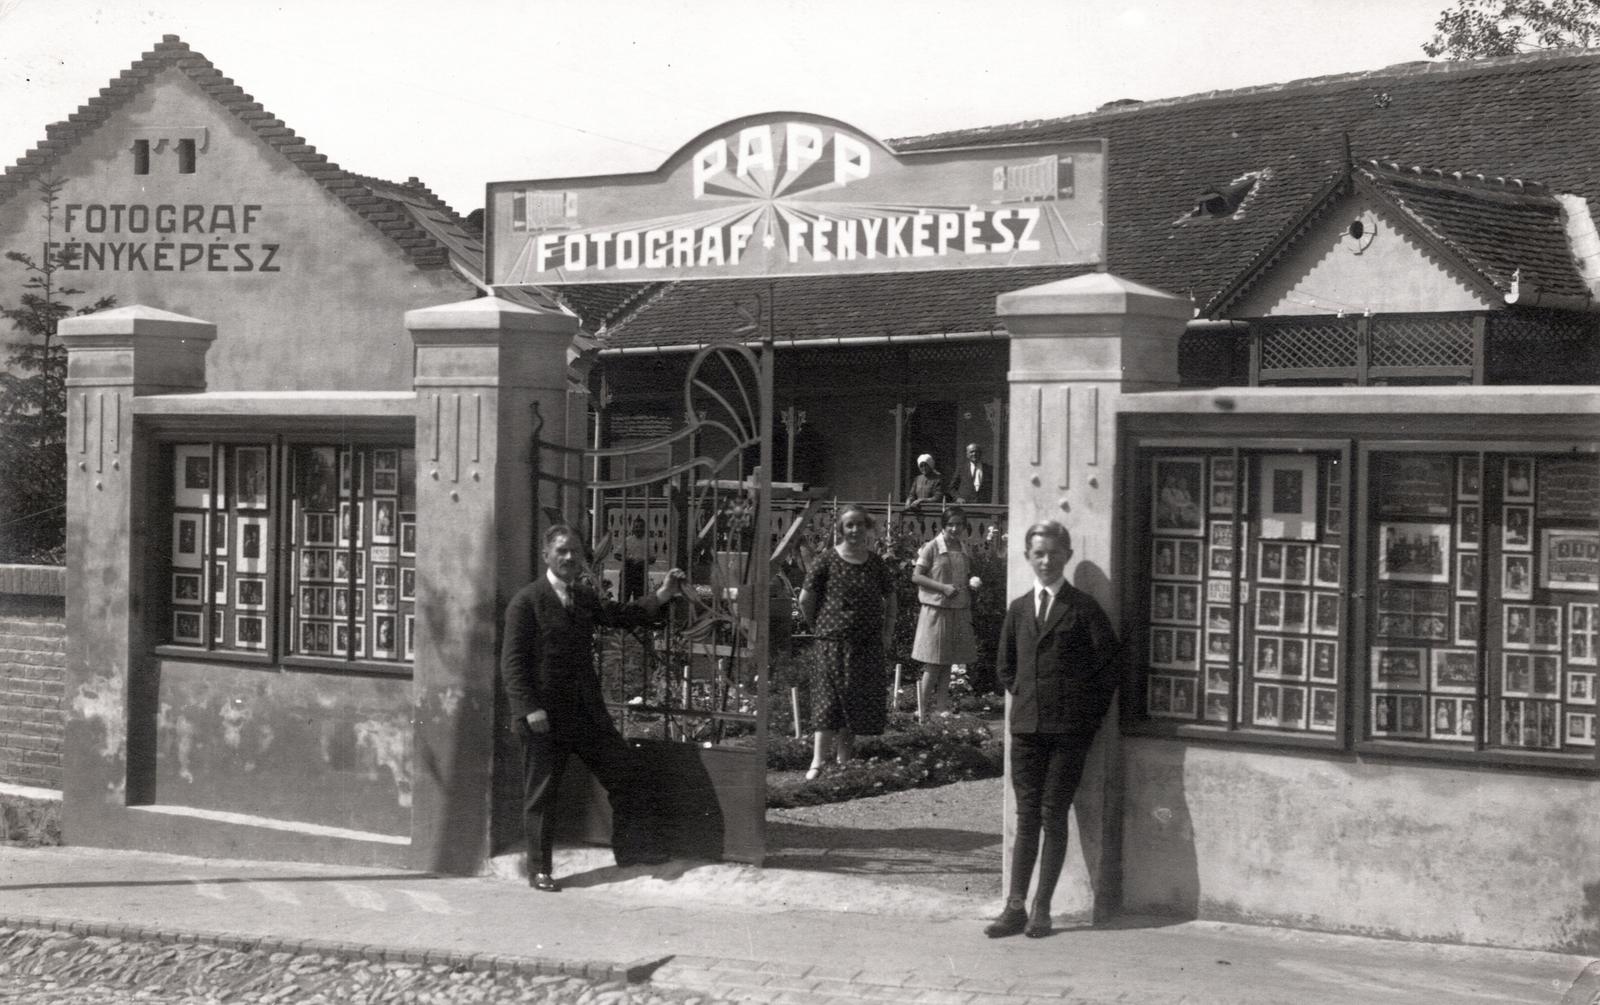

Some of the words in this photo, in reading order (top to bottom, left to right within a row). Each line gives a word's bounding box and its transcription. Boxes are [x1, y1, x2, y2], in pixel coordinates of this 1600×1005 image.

[692, 122, 871, 199] PAPP
[65, 204, 262, 234] FOTOGRAF
[536, 224, 754, 273] FOTOGRAF
[788, 204, 1041, 264] FÉNYKÉPÉSZ
[43, 236, 281, 271] FÉNYKÉPÉSZ
